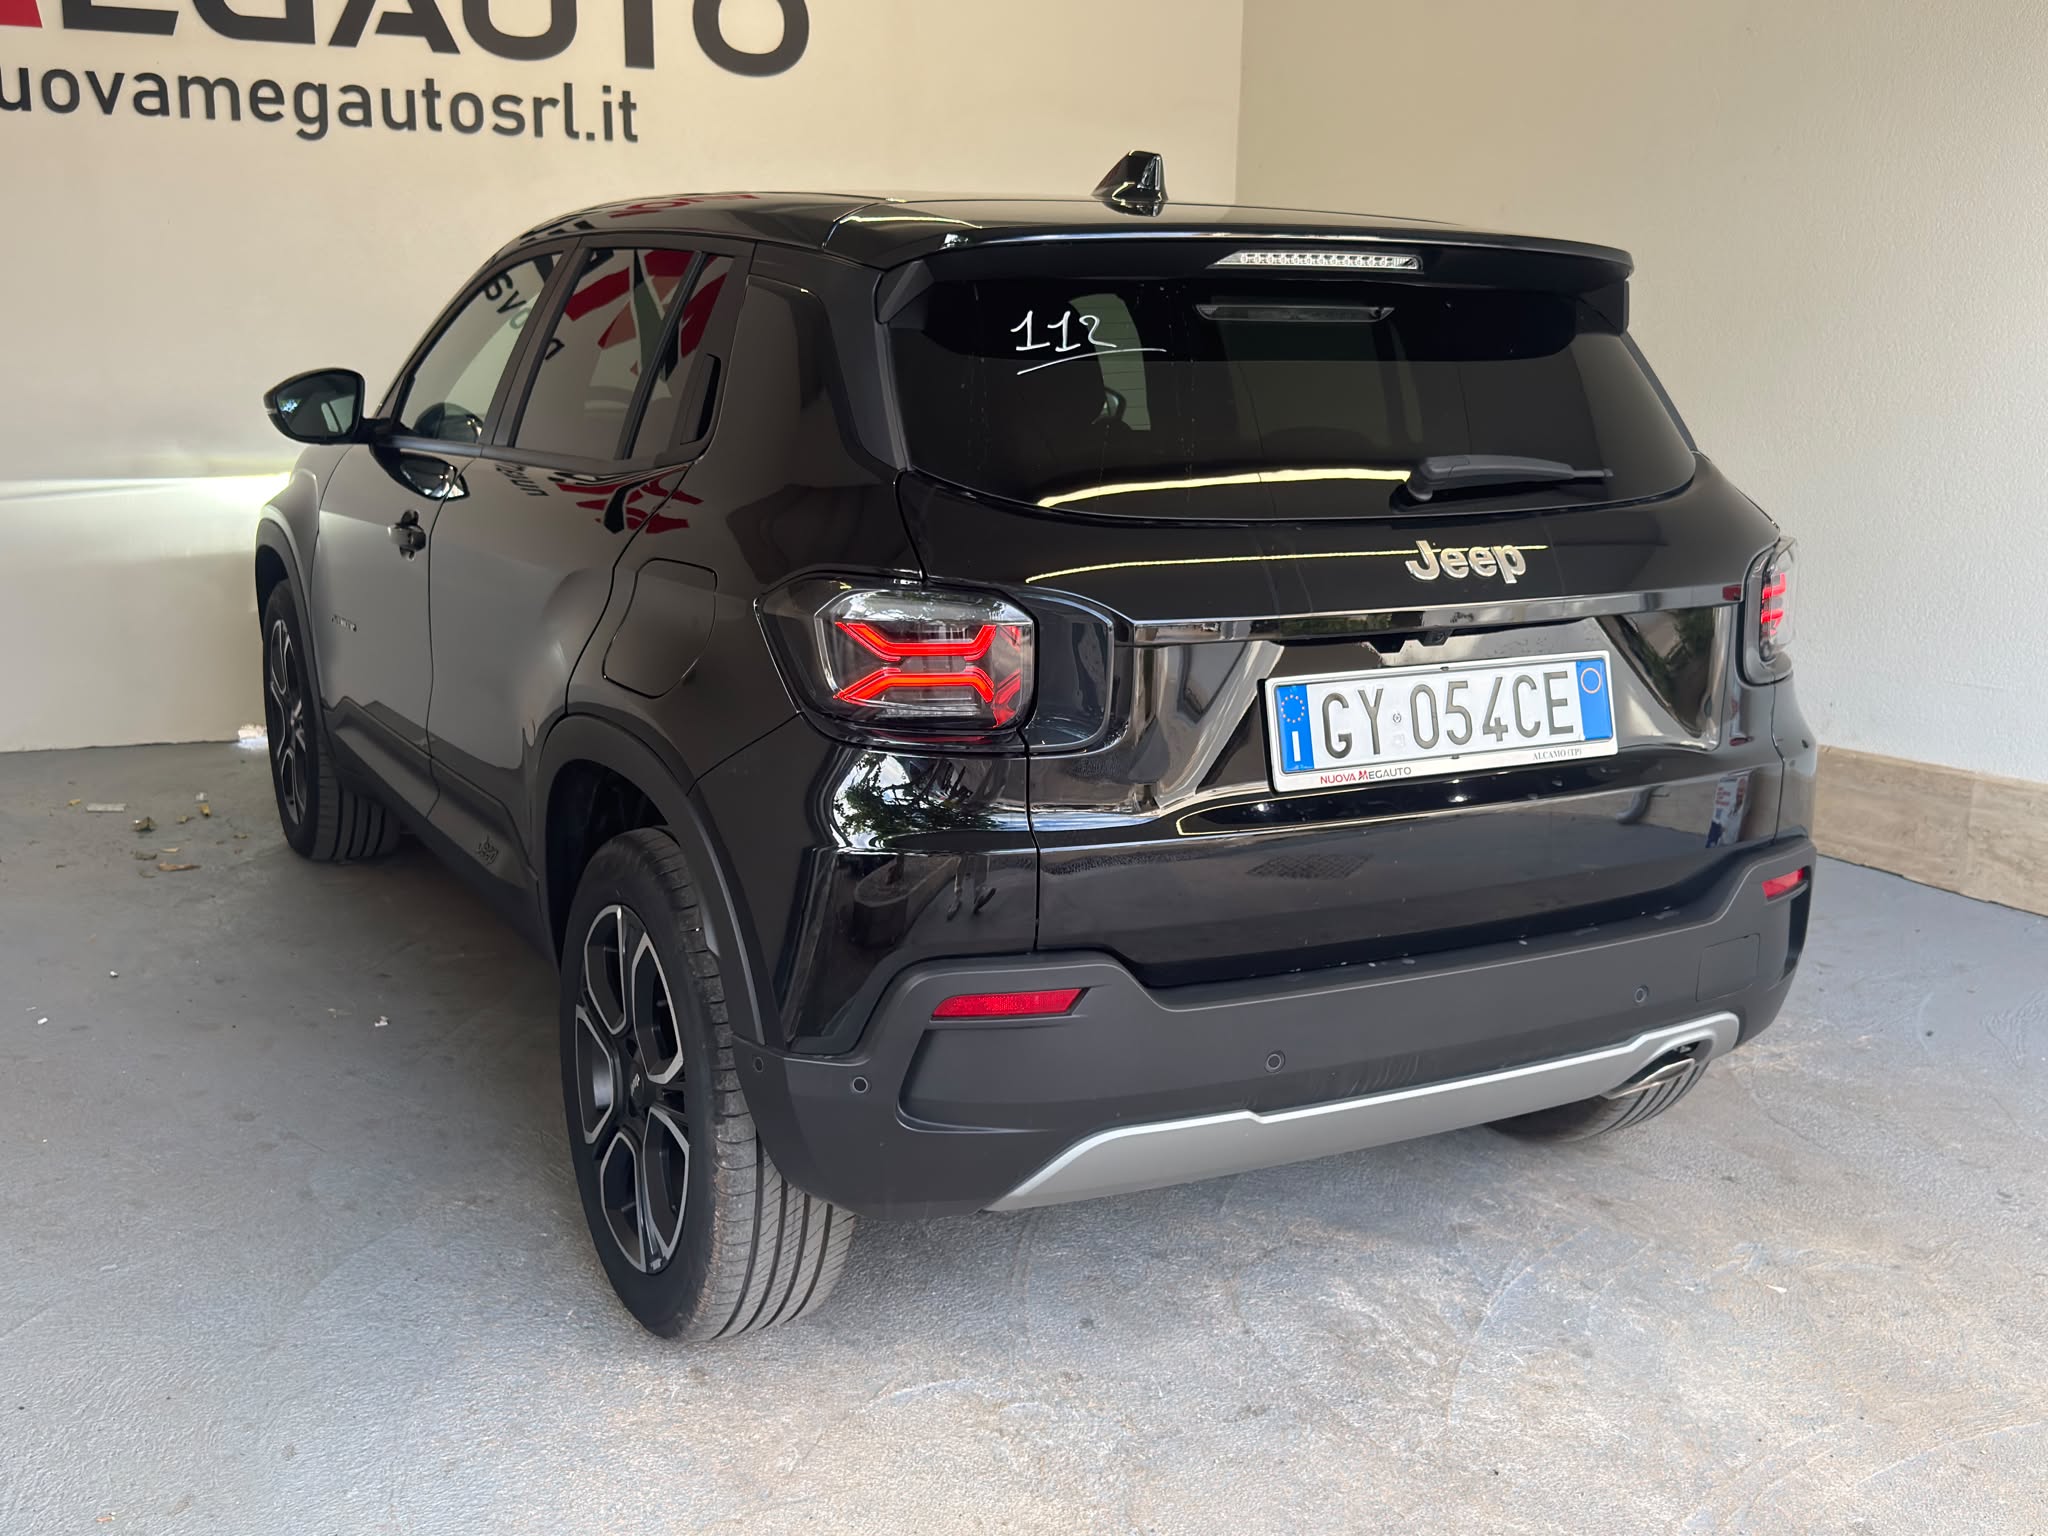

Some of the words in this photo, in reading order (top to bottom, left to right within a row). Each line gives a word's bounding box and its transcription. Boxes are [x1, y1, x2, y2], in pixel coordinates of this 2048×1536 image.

[1010, 310, 1117, 352] 112
[1405, 540, 1527, 584] Jeep
[1321, 687, 1385, 760] GY
[1409, 670, 1575, 751] 054CE
[1320, 772, 1357, 785] NUOVA
[1358, 766, 1412, 781] MEGAUTO
[1533, 748, 1567, 761] ALCAMO
